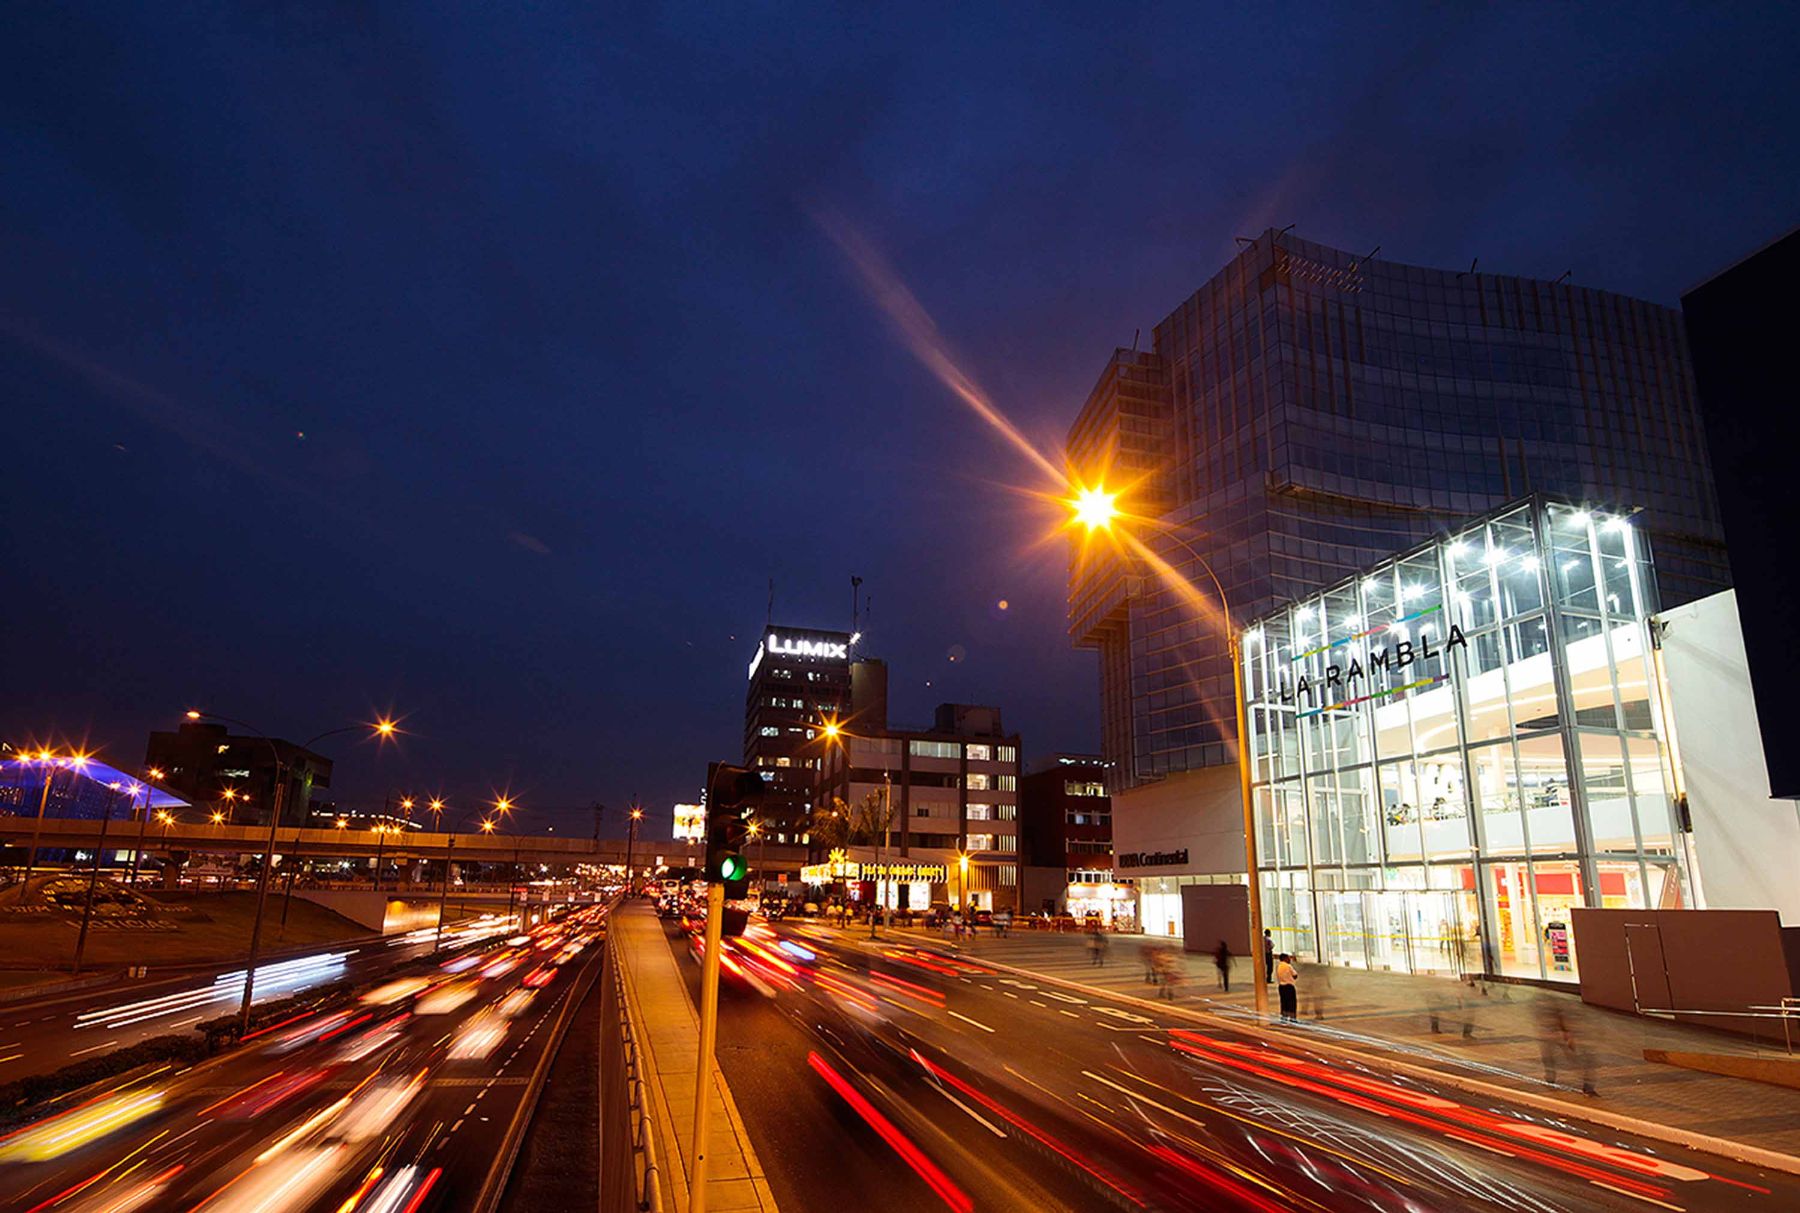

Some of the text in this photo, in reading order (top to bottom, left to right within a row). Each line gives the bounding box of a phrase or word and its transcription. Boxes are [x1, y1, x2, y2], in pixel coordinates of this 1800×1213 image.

[768, 633, 847, 659] LUMIX
[1280, 624, 1468, 702] LA RAMBLA
